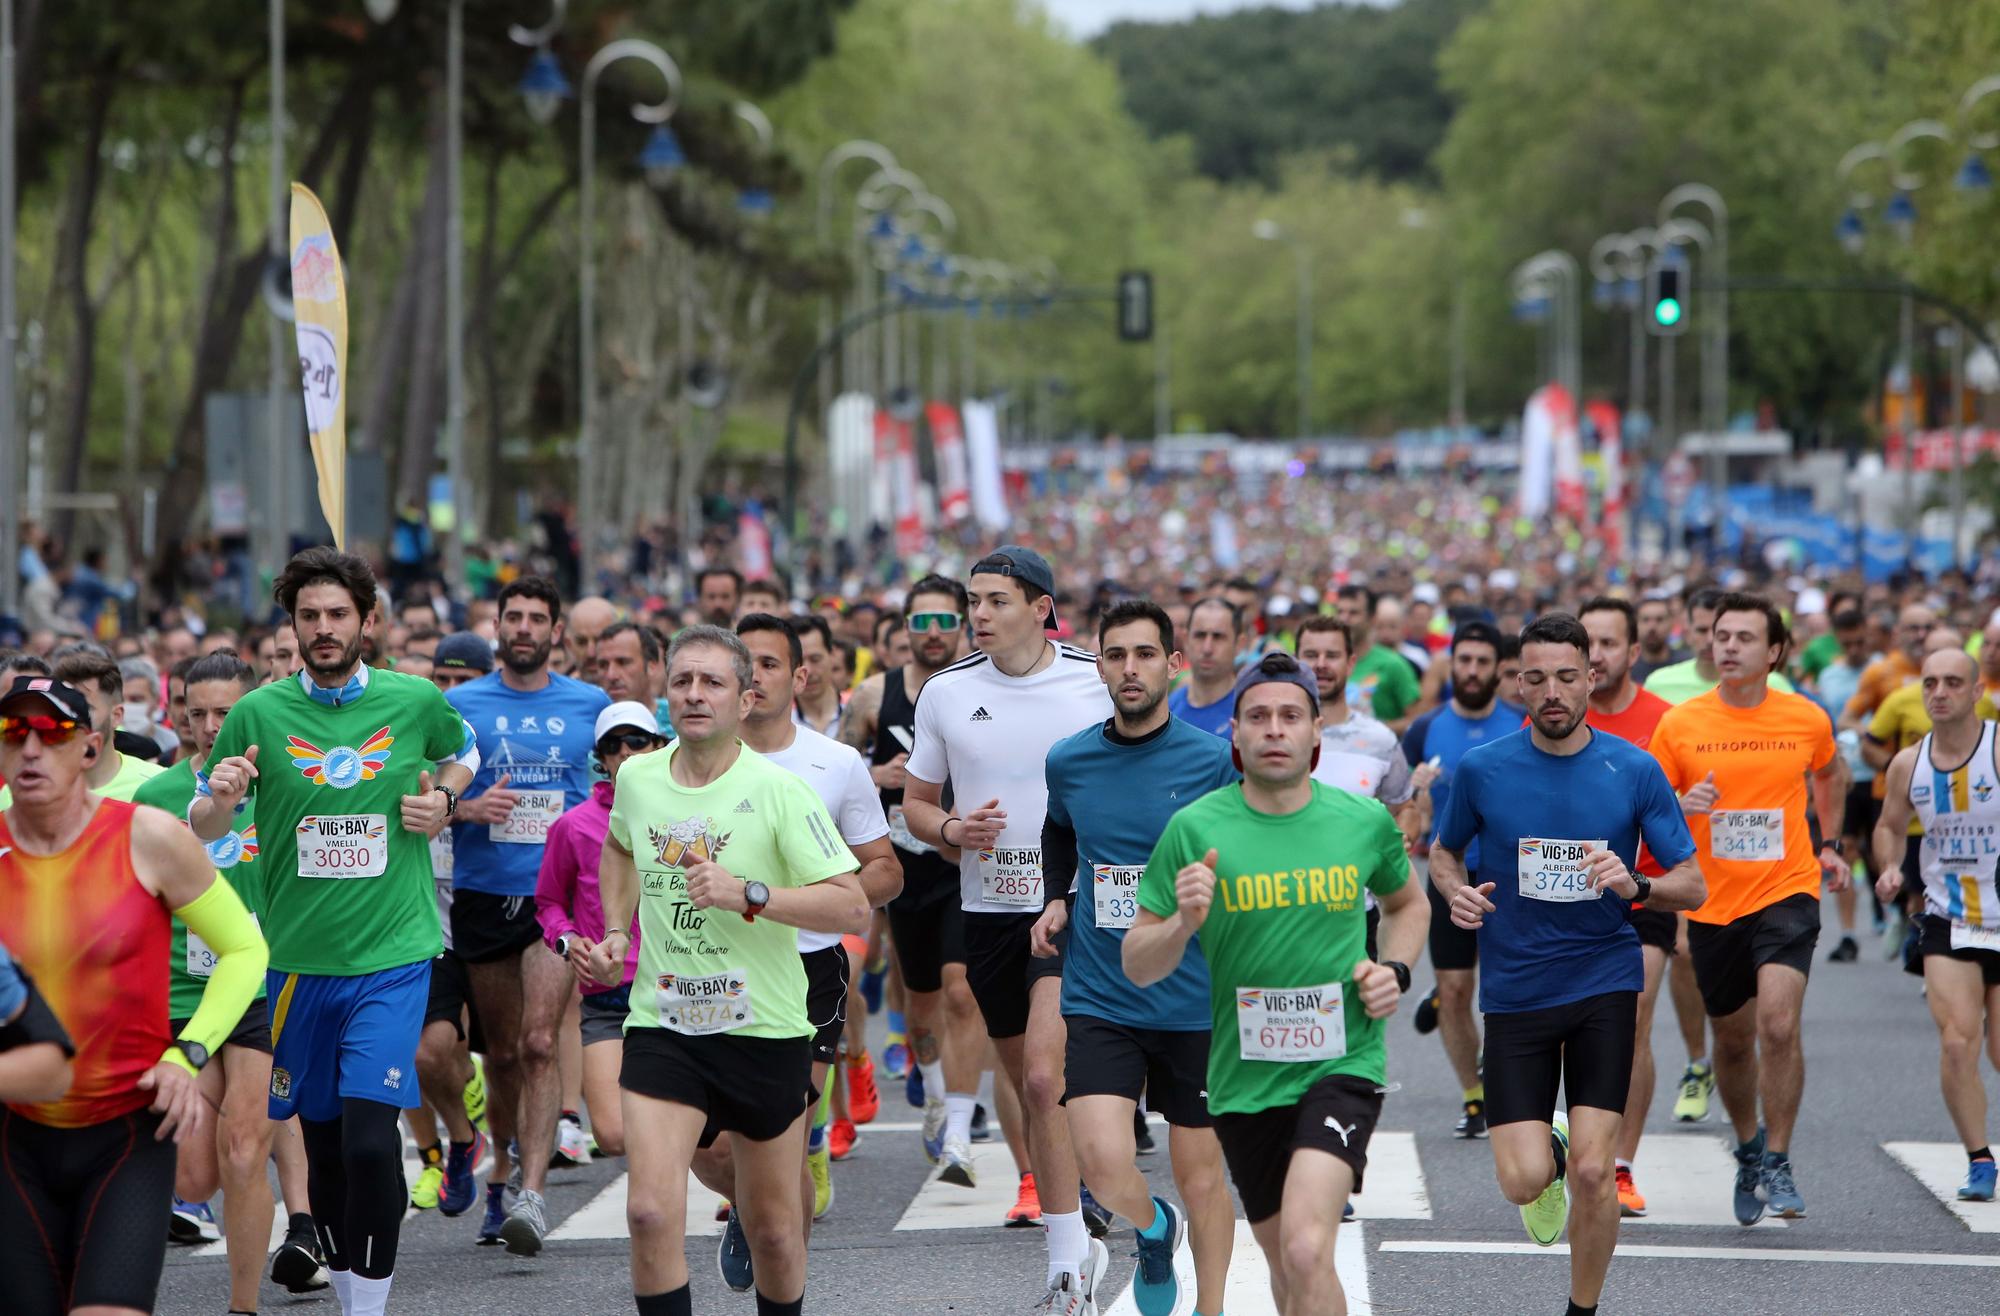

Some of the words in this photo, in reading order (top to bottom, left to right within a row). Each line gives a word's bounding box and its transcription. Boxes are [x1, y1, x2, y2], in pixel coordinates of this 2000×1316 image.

[1696, 741, 1796, 753] METROPOLITAN
[532, 796, 550, 808] BAY
[318, 821, 338, 836] VIG
[346, 820, 369, 835] BAY
[504, 819, 549, 835] 2365
[1728, 816, 1744, 828] VIG
[1750, 816, 1768, 827] BAY
[1724, 836, 1769, 852] 3414
[315, 848, 370, 867] 3030
[995, 851, 1012, 865] VIG
[1019, 851, 1040, 864] BAY
[1542, 845, 1560, 860] VIG
[1568, 846, 1584, 860] BA
[644, 873, 664, 890] Café
[994, 877, 1041, 895] 2857
[1112, 872, 1130, 886] VIG
[1535, 872, 1588, 892] 3749
[1220, 864, 1359, 912] LODEIROS
[670, 902, 706, 930] Tito
[665, 940, 692, 955] Viernes
[697, 941, 730, 955] Cañero
[676, 981, 696, 996] VIG
[702, 978, 728, 996] BAY
[1264, 996, 1287, 1012] VIG
[1295, 993, 1322, 1012] BAY
[676, 1004, 733, 1025] 1874
[1267, 1017, 1316, 1026] BRUNO84
[1260, 1026, 1324, 1048] 6750
